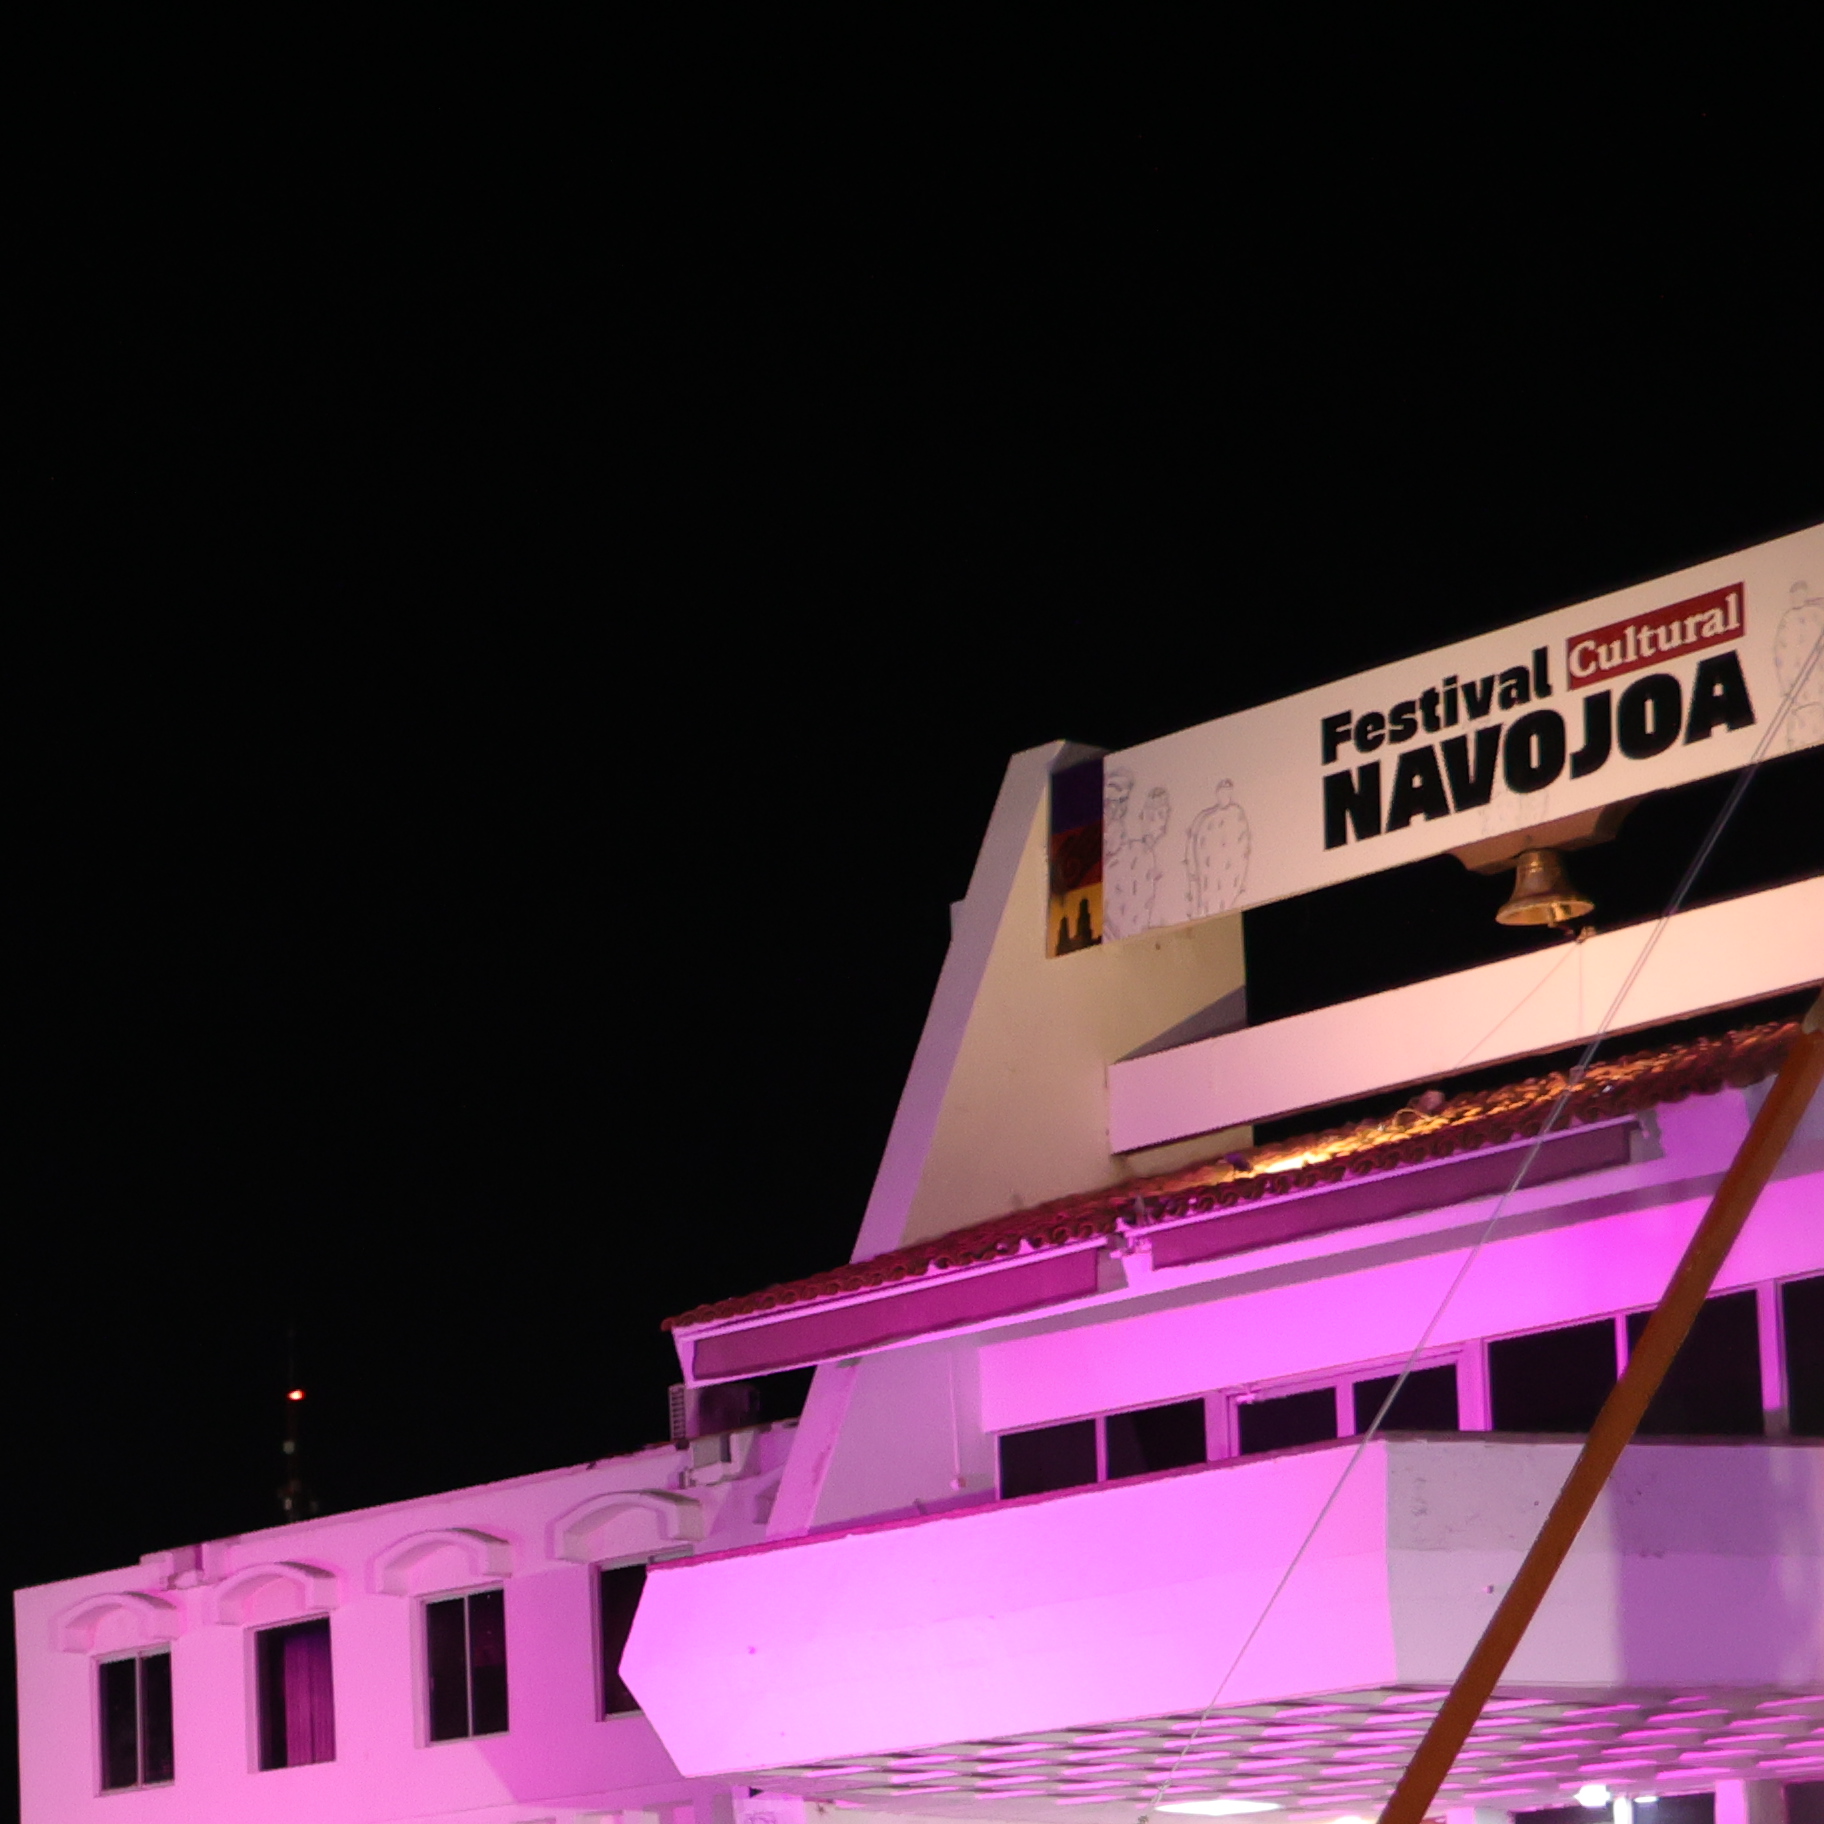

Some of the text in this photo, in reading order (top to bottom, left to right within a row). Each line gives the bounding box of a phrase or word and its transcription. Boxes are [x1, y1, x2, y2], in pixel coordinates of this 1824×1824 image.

[1320, 593, 1742, 765] Festival Cultural
[1323, 650, 1758, 850] NAVOJOA
